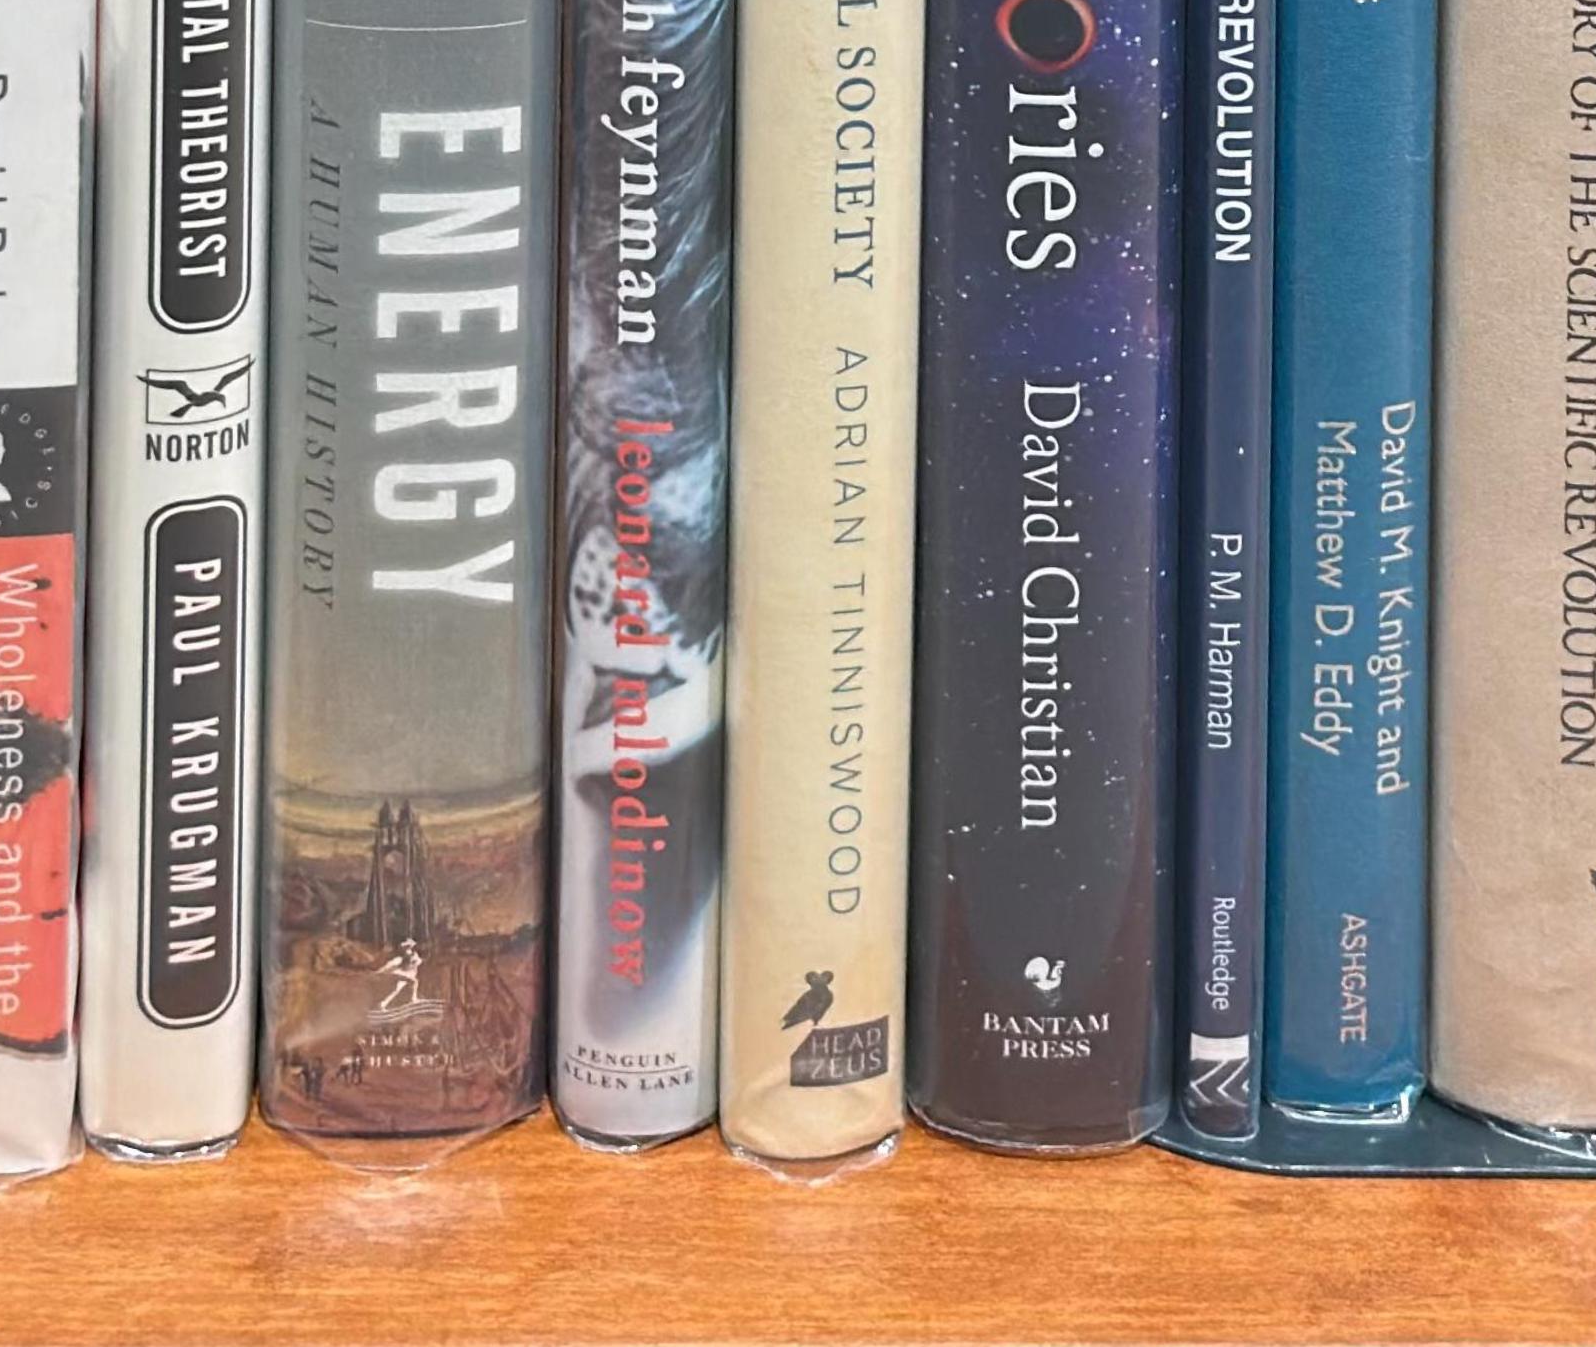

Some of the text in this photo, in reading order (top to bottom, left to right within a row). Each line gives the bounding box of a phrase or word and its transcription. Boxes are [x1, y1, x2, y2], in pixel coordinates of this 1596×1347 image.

[178, 82, 228, 278] THEORIST
[601, 55, 685, 347] feynman
[834, 45, 876, 289] SOCIETY
[145, 420, 251, 462] NORTON
[303, 99, 341, 609] A HUMAN HISTORY
[372, 105, 522, 604] ENERGY
[826, 345, 869, 916] ADRIAN TINNISWOOD
[1021, 380, 1081, 830] David Christian
[1207, 533, 1242, 749] P. M. Harman
[1300, 421, 1357, 755] Matthew D. Eddy
[1366, 401, 1416, 795] David M. Knight and
[167, 559, 220, 965] PAUL KRUGMAN
[608, 418, 675, 987] leonard mlodinow
[578, 1045, 676, 1068] PENGUIN
[812, 1027, 882, 1054] HEAD
[983, 1012, 1110, 1035] BANTAM
[1003, 1039, 1091, 1058] PRESS
[1211, 897, 1235, 1010] Routledge
[1340, 913, 1368, 1044] ASHGATE
[563, 1060, 693, 1091] ALLEN LANE
[811, 1052, 882, 1079] ZEUS
